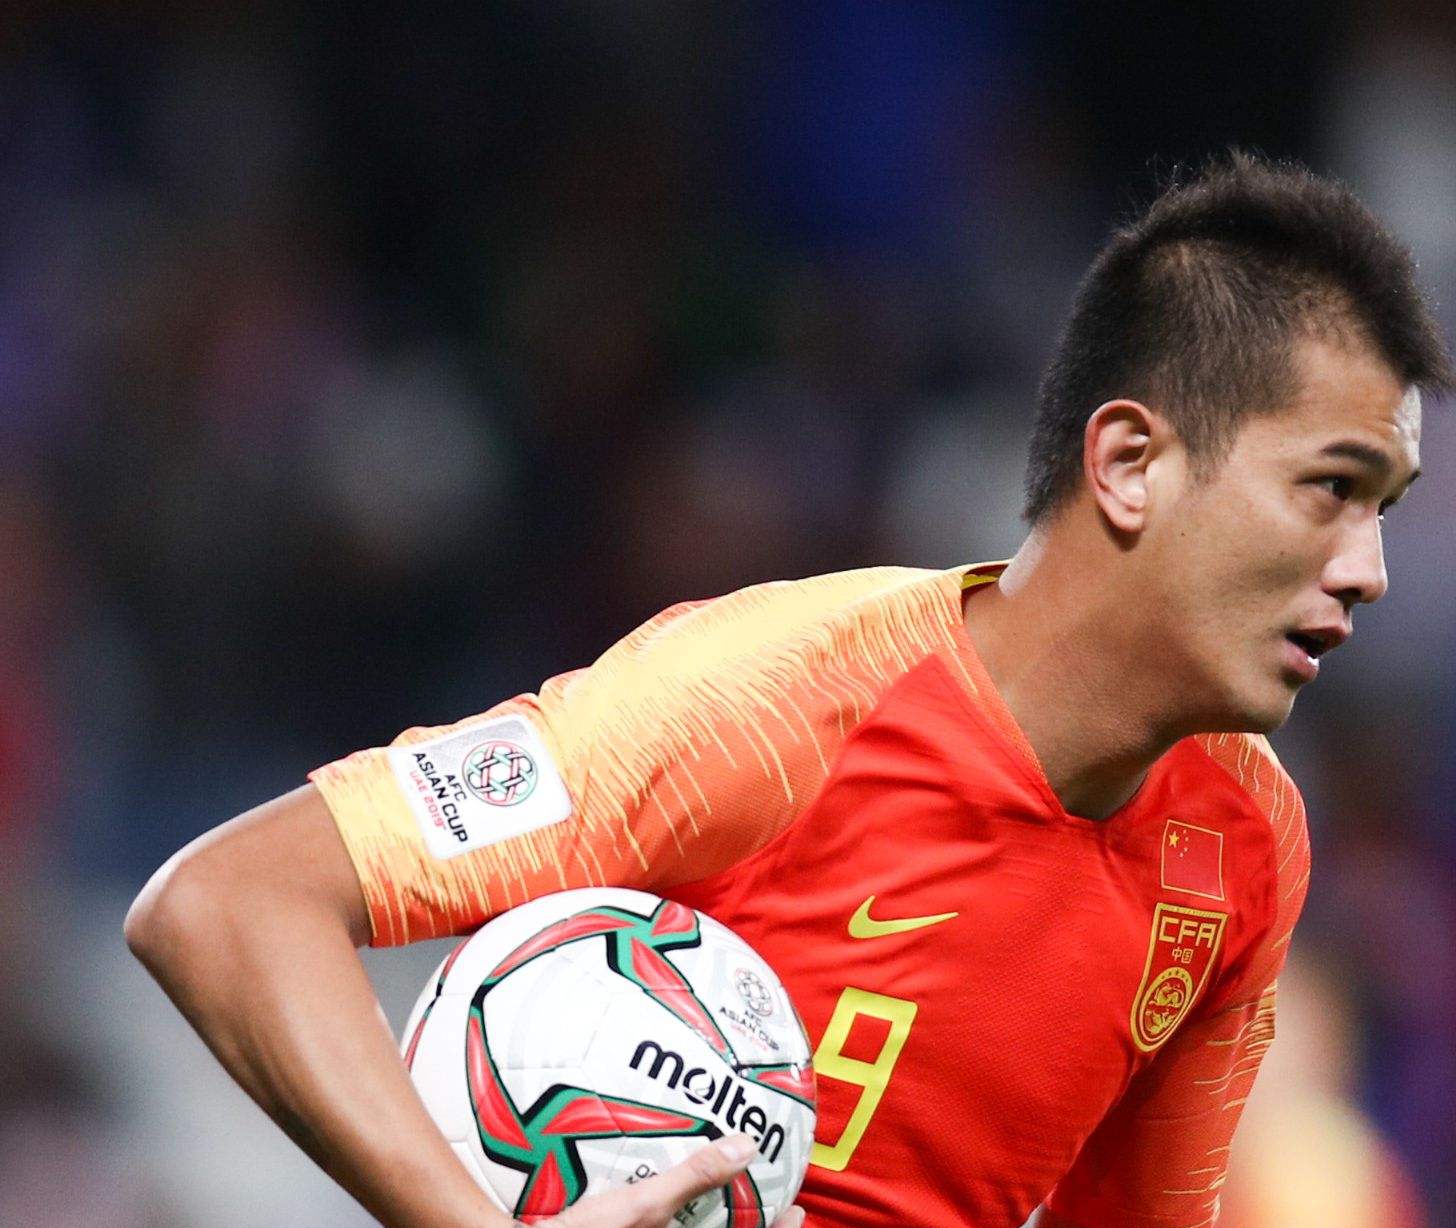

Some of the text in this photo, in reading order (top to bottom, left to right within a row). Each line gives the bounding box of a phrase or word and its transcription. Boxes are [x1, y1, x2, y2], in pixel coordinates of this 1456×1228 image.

[412, 752, 469, 843] ASIAN CUP
[444, 774, 468, 802] AFC
[1159, 916, 1217, 948] CFA
[629, 1040, 785, 1164] molten
[810, 986, 919, 1172] 9
